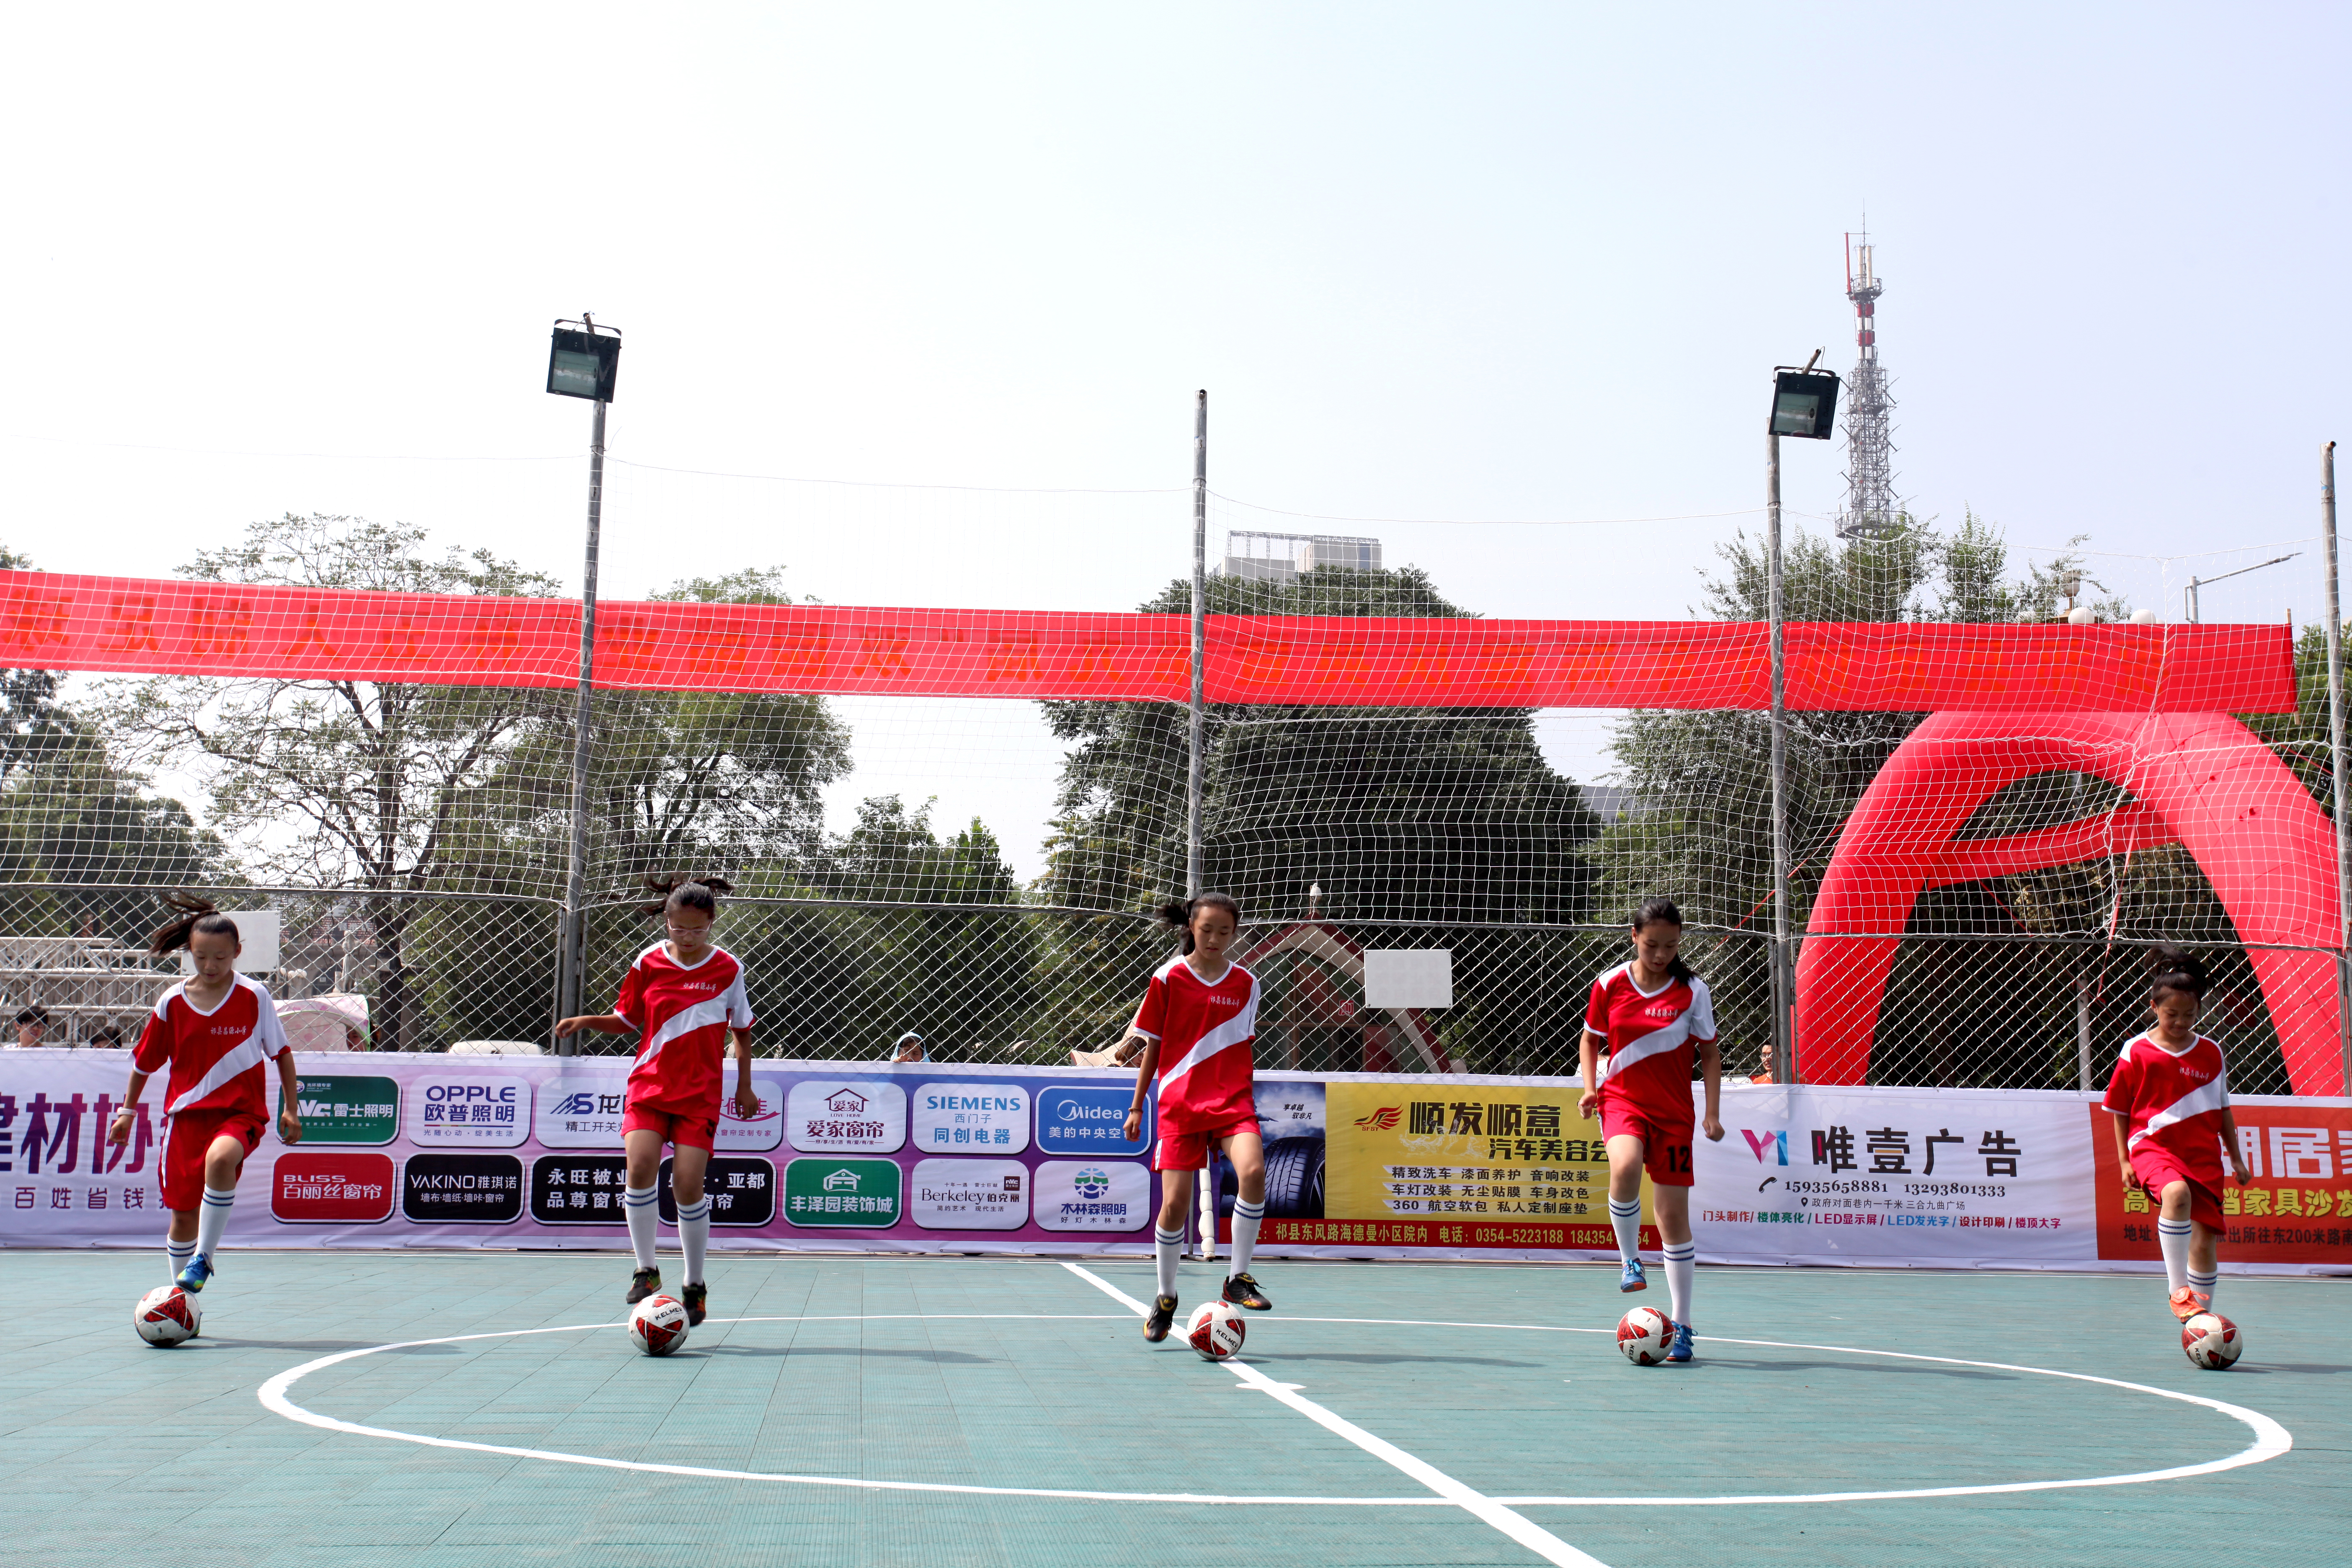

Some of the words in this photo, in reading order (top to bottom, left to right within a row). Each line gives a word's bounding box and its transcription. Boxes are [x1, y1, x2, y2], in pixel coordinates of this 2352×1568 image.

[210, 1026, 247, 1035] 祁县昌源小学
[426, 1086, 516, 1102] OPPLE
[334, 1104, 394, 1117] 雷士照明
[834, 1100, 859, 1112] 爱家
[926, 1096, 1021, 1111] SIEMENS
[424, 1104, 515, 1122] 欧普照明
[954, 1113, 992, 1124] 西门子
[1065, 1106, 1123, 1119] Midea
[1409, 1101, 1561, 1137] 顺发顺意
[807, 1120, 884, 1138] 爱家窗帘
[934, 1127, 1011, 1144] 同创电器
[1049, 1126, 1126, 1139] 美的中央空
[1811, 1125, 2022, 1177] 唯壹广告
[1666, 1146, 1690, 1172] 12
[477, 1175, 517, 1189] 雅琪诺
[1392, 1167, 1452, 1179] 精致洗车
[1461, 1168, 1521, 1181] 漆面养护
[1530, 1169, 1590, 1182] 音响改装
[283, 1184, 382, 1200] 百丽丝窗帘
[922, 1188, 985, 1204] Berkeley
[987, 1193, 1020, 1202] 伯克丽
[1392, 1184, 1452, 1197] 车灯改装
[1461, 1185, 1521, 1198] 无尘贴膜
[1530, 1186, 1590, 1199] 车身改色
[1785, 1180, 1888, 1194] 15935658881
[1904, 1182, 2005, 1197] 13293801333
[790, 1196, 893, 1213] 丰泽园装饰城
[1061, 1203, 1127, 1215] 木林森照明
[1393, 1200, 1419, 1210] 360
[1428, 1200, 1487, 1212] 航空软包
[1497, 1201, 1588, 1214] 私人定制座垫
[1812, 1198, 1903, 1209] 政府对面巷内一千米
[1906, 1200, 1965, 1210] 三合九曲广场
[655, 1308, 680, 1321] KELME
[1215, 1328, 1236, 1347] KELME
